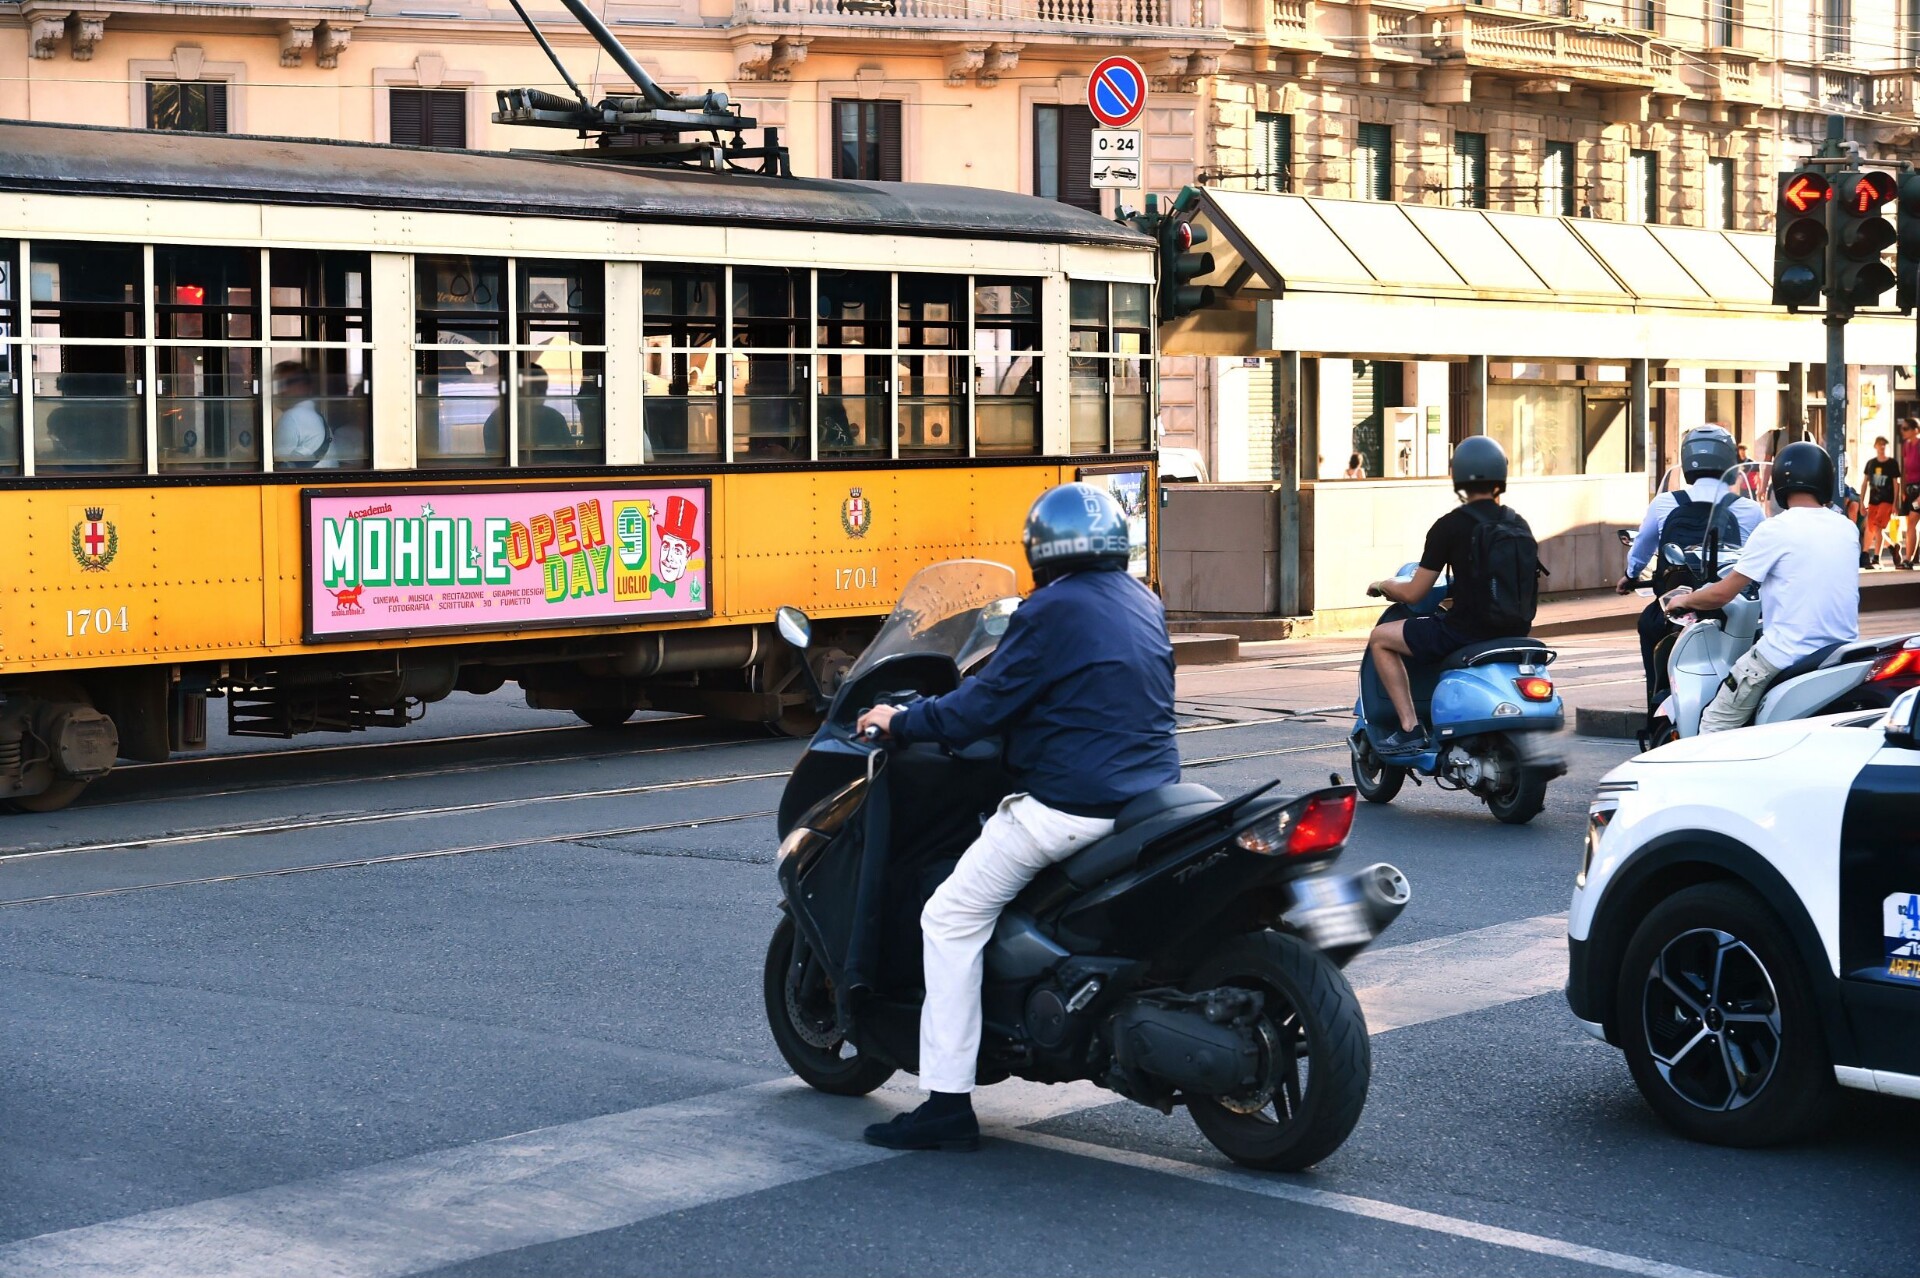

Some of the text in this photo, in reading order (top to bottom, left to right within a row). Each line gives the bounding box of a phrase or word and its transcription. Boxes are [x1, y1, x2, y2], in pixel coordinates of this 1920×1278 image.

[348, 503, 393, 519] Accademia
[505, 499, 606, 571] OPEN
[617, 507, 647, 571] 9
[323, 518, 511, 588] MOHOLE
[543, 545, 612, 604] DAY
[617, 575, 648, 595] LUGLIO
[835, 567, 877, 591] 1704
[372, 588, 545, 605] CINEMA MUSICA RECITAZIONE GRAPHIC DESIGN
[388, 603, 430, 612] FOTOGRAFIA
[438, 601, 475, 610] SCRITTURA
[500, 598, 531, 606] FUMETTO
[66, 606, 129, 637] 1704
